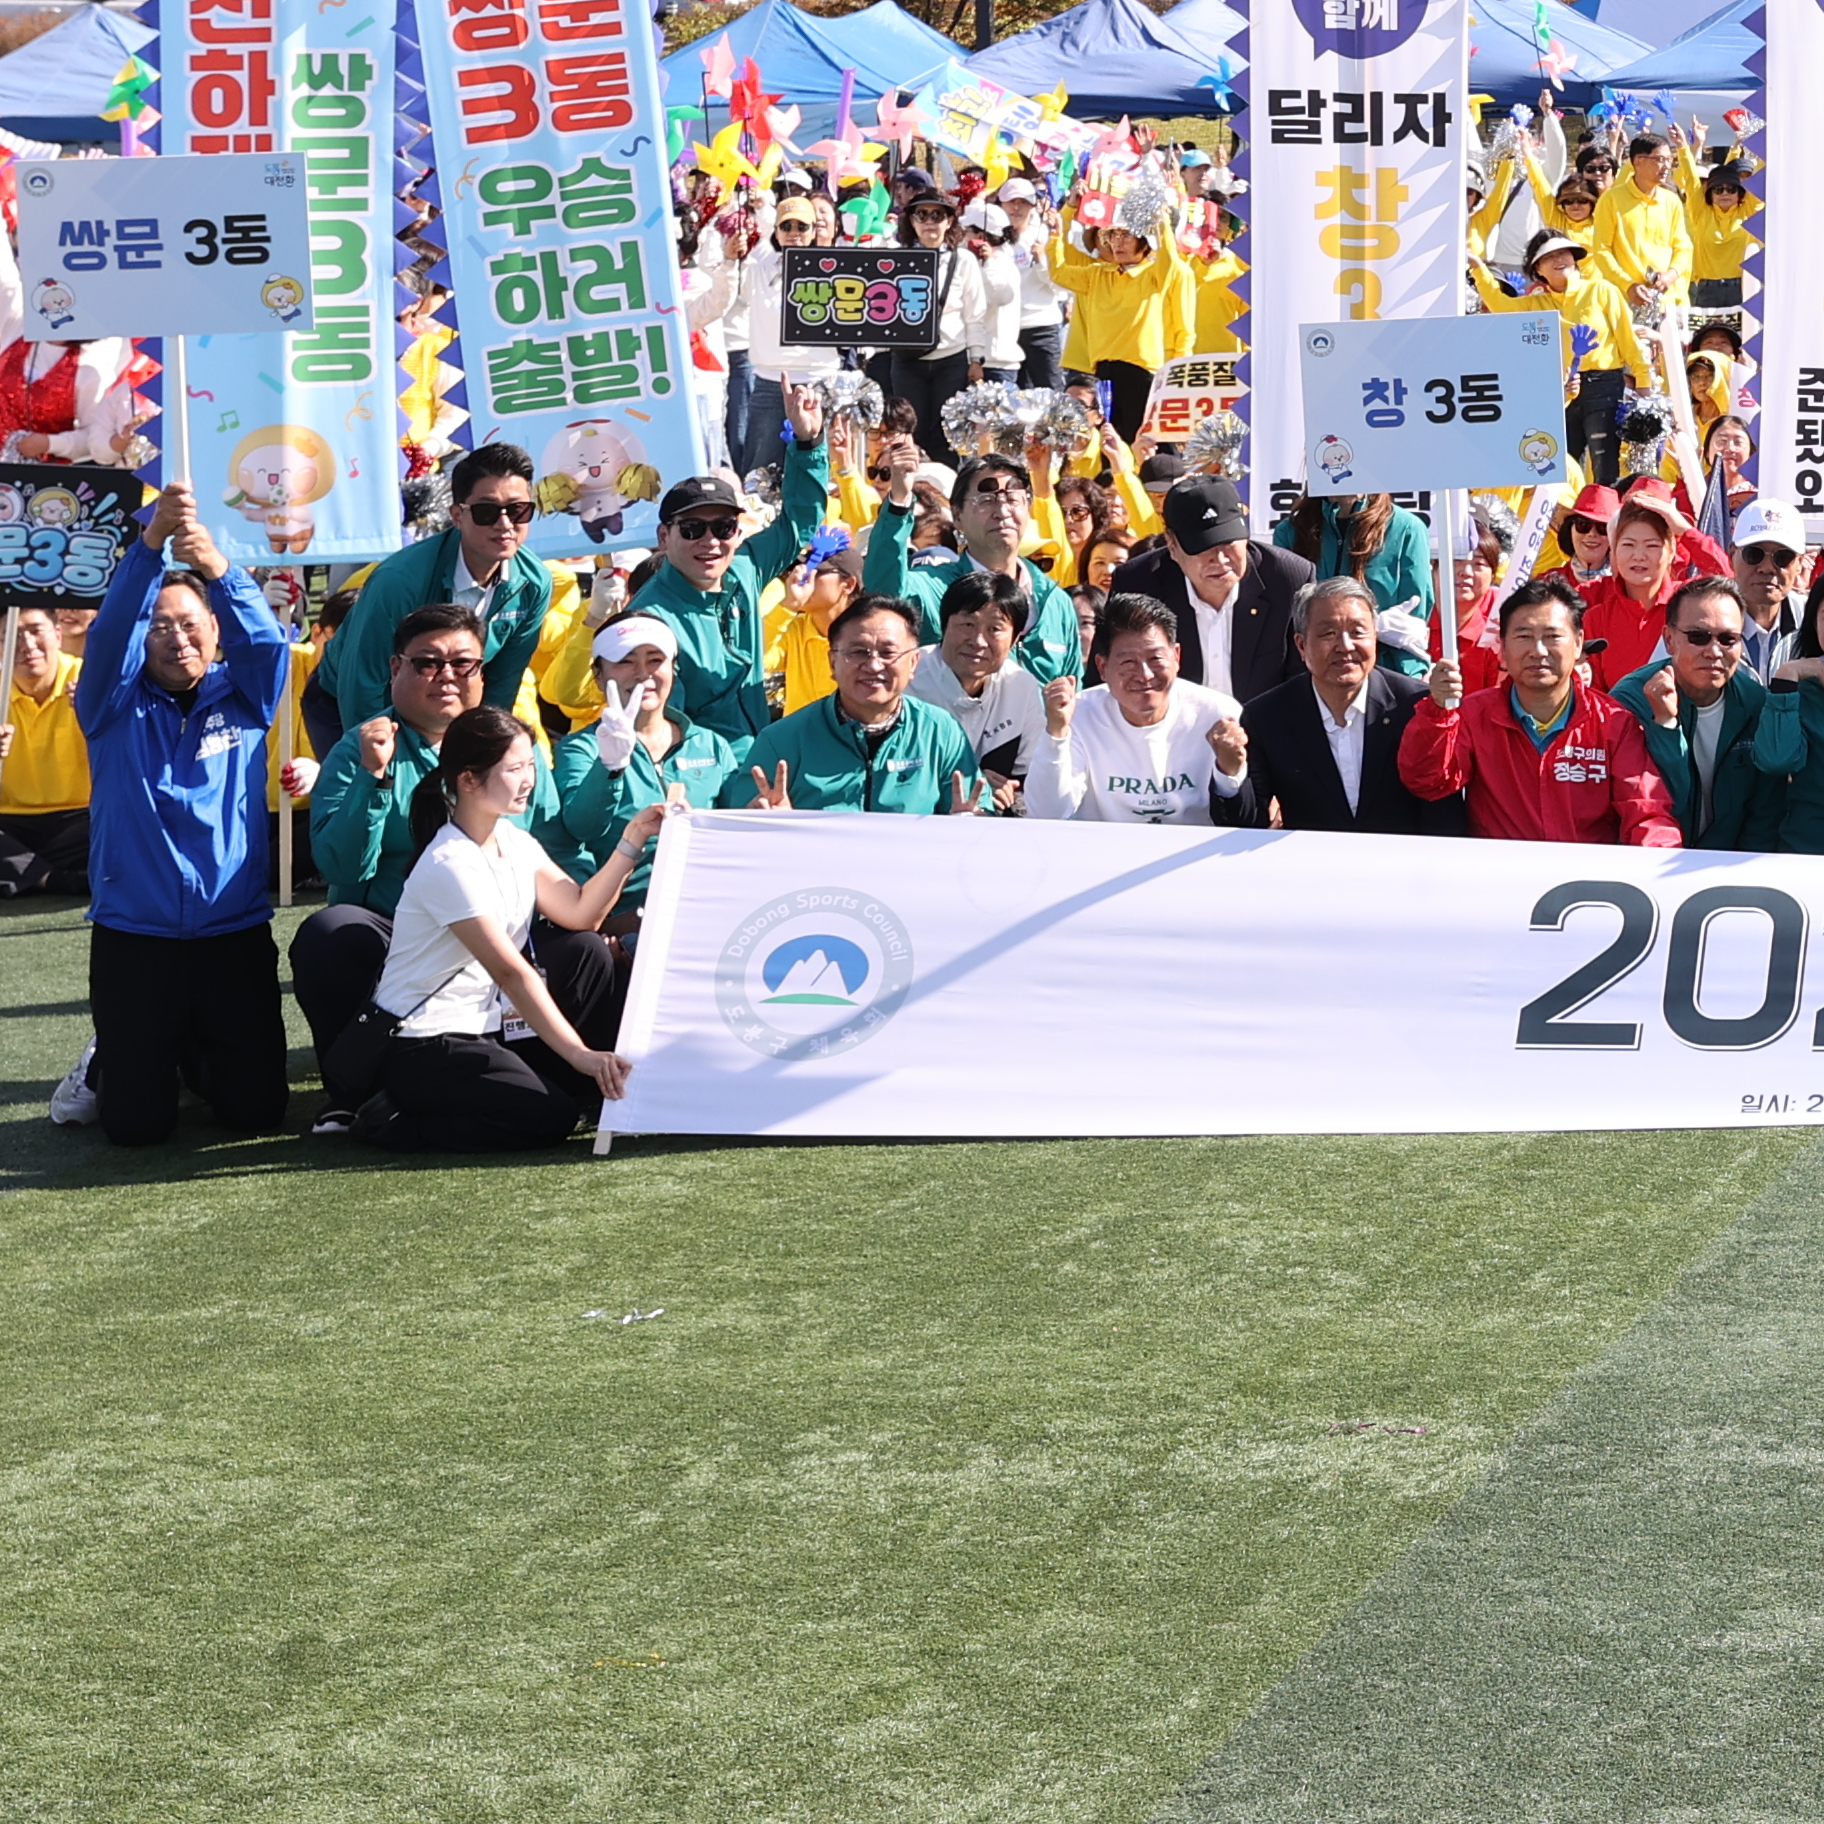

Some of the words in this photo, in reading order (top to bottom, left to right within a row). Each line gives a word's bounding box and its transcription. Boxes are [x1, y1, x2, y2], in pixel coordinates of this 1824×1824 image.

[458, 51, 634, 146] 3동
[1267, 88, 1453, 148] 달리자
[291, 51, 375, 384] 쌍문3동
[478, 154, 639, 238] 우승
[59, 217, 163, 272] 쌍문
[183, 214, 272, 266] 3동
[491, 241, 648, 326] 하러
[791, 276, 932, 326] 쌍문3동
[487, 326, 671, 415] 출발!
[1362, 377, 1408, 428] 창
[1424, 372, 1504, 424] 3동
[1107, 773, 1196, 796] PRADA
[1553, 761, 1608, 784] 정승구
[1137, 798, 1168, 807] MILANO
[727, 902, 790, 959] Dobong
[796, 893, 859, 910] Sports
[863, 903, 909, 961] Council
[725, 1005, 789, 1055] 도봉구
[809, 1007, 887, 1054] 체육회
[1740, 1093, 1797, 1115] 일시:
